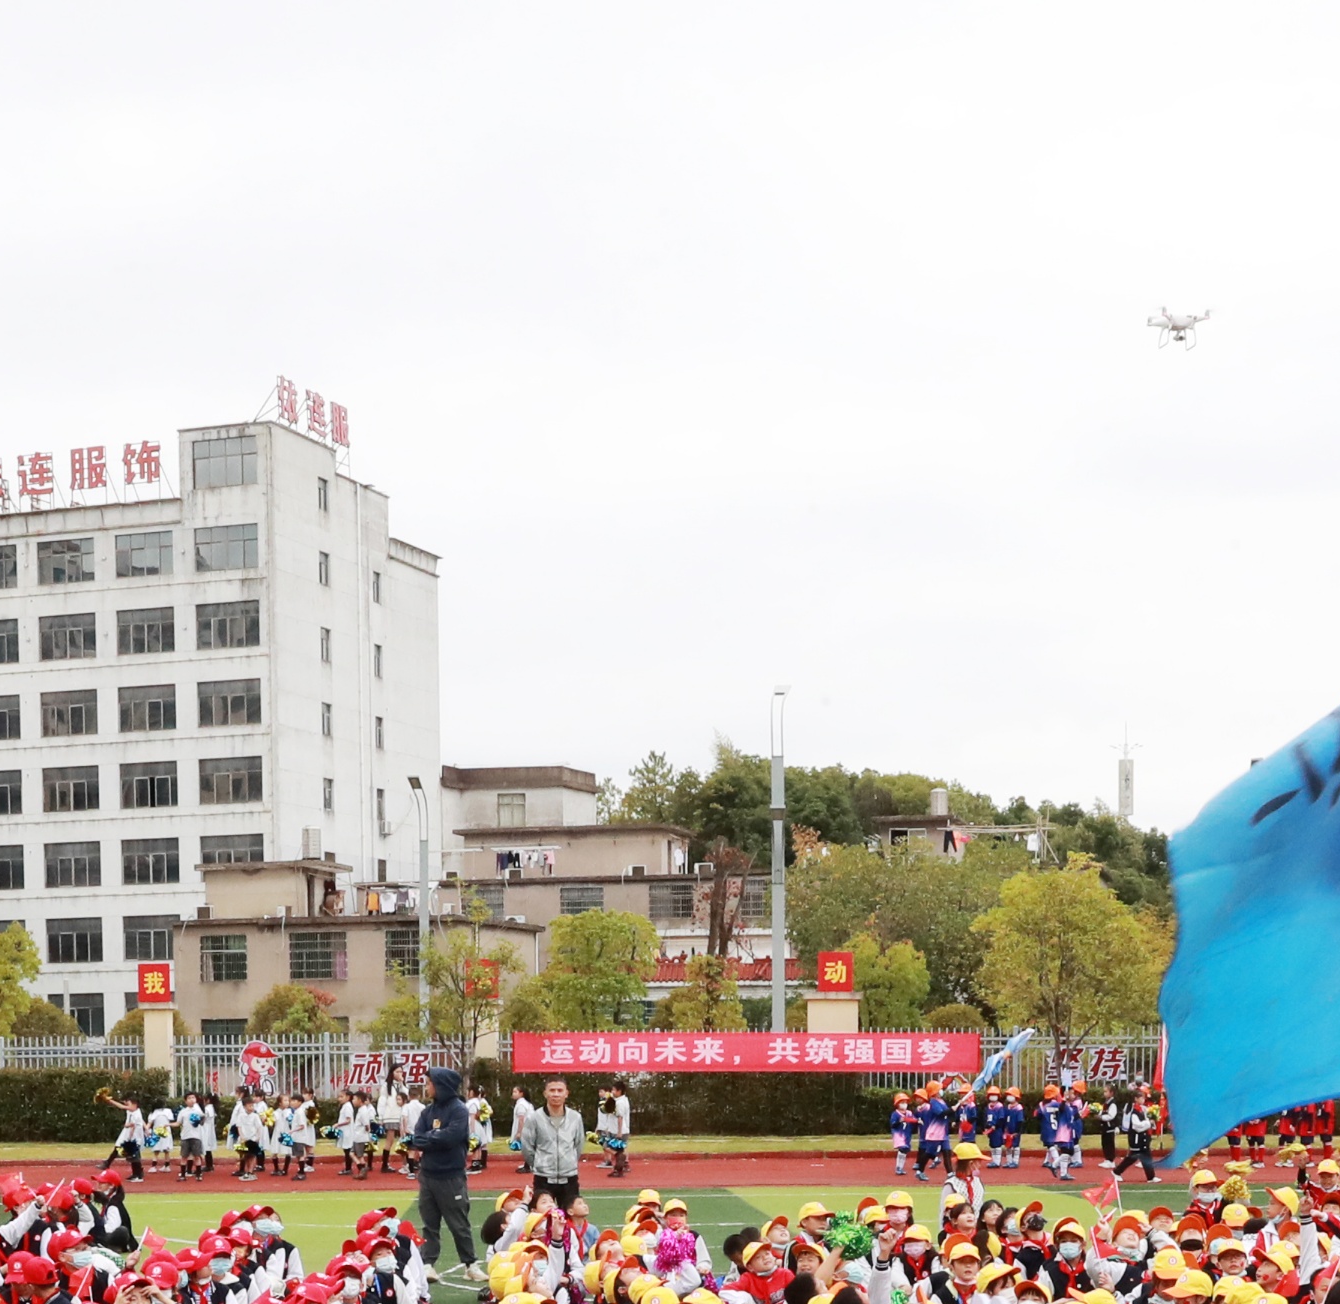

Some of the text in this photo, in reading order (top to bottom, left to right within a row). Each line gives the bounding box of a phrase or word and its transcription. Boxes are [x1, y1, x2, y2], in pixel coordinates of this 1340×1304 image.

[143, 971, 165, 995] 我
[824, 960, 847, 984] 动
[349, 1053, 429, 1084] 顽强
[1050, 1114, 1058, 1130] 5
